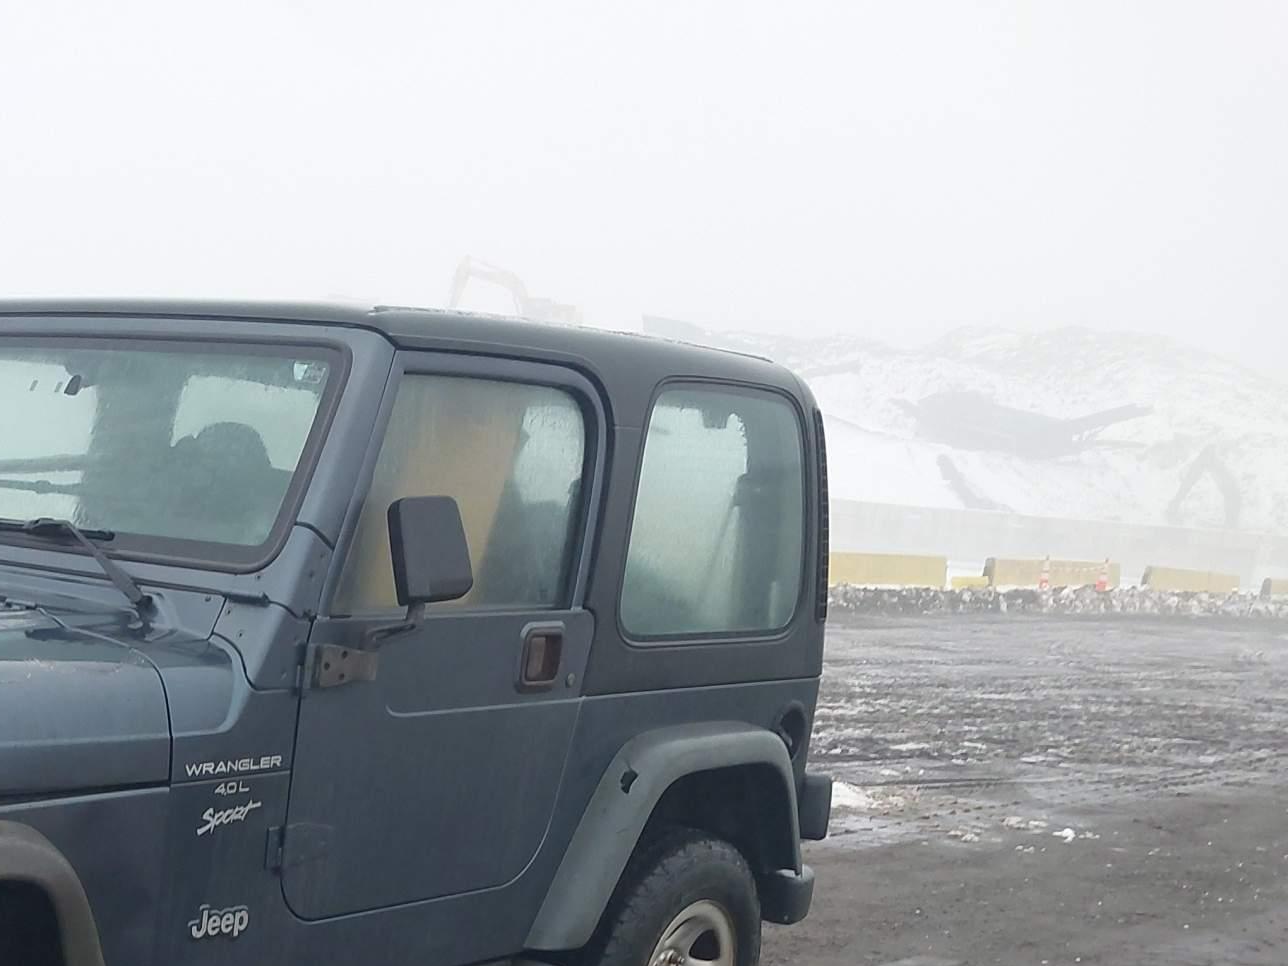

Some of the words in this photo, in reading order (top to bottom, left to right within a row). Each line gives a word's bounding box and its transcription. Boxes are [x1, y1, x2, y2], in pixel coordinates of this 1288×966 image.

[185, 755, 282, 777] WRANGLER
[196, 800, 262, 836] Sport
[190, 906, 249, 938] Jeep
